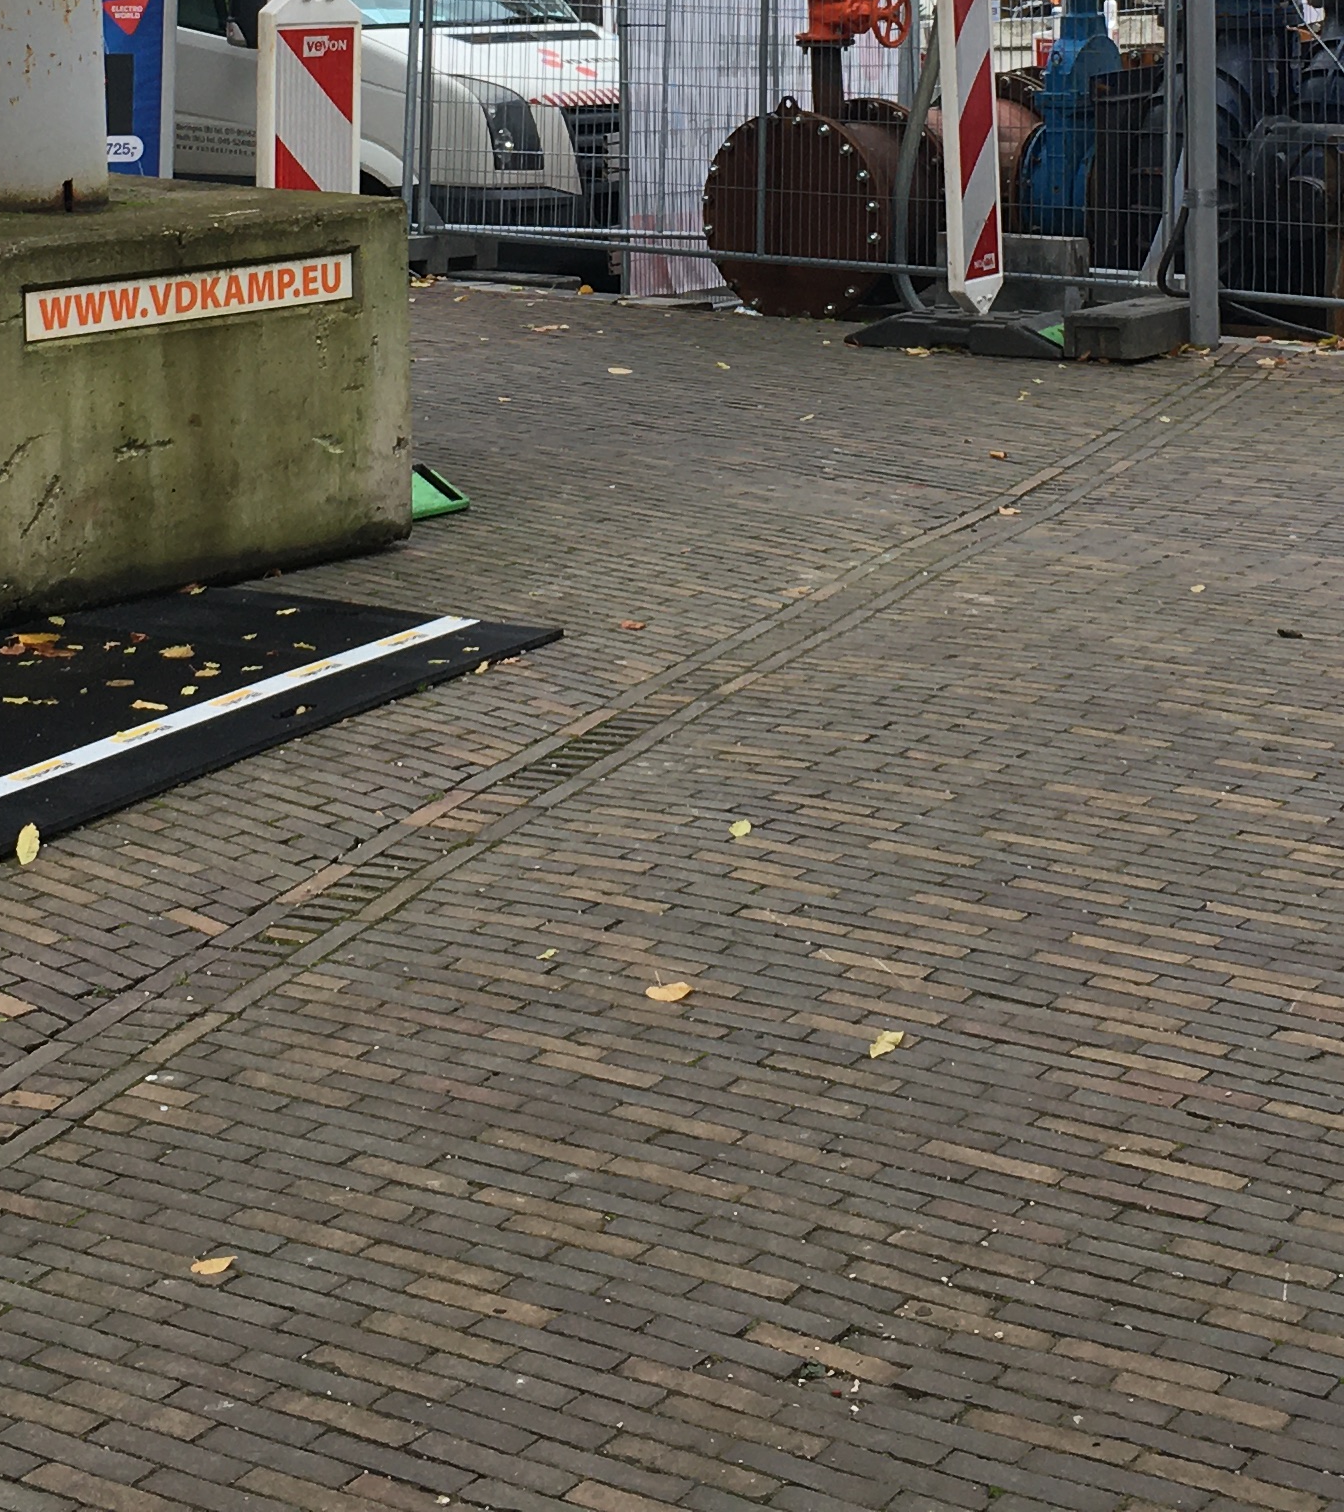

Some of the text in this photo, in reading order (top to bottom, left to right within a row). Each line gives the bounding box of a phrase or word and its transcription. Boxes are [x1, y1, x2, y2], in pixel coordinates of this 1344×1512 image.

[111, 5, 144, 13] ELECTRO
[114, 12, 141, 20] WORLD
[38, 261, 342, 332] WWW.VDKAMP.EU
